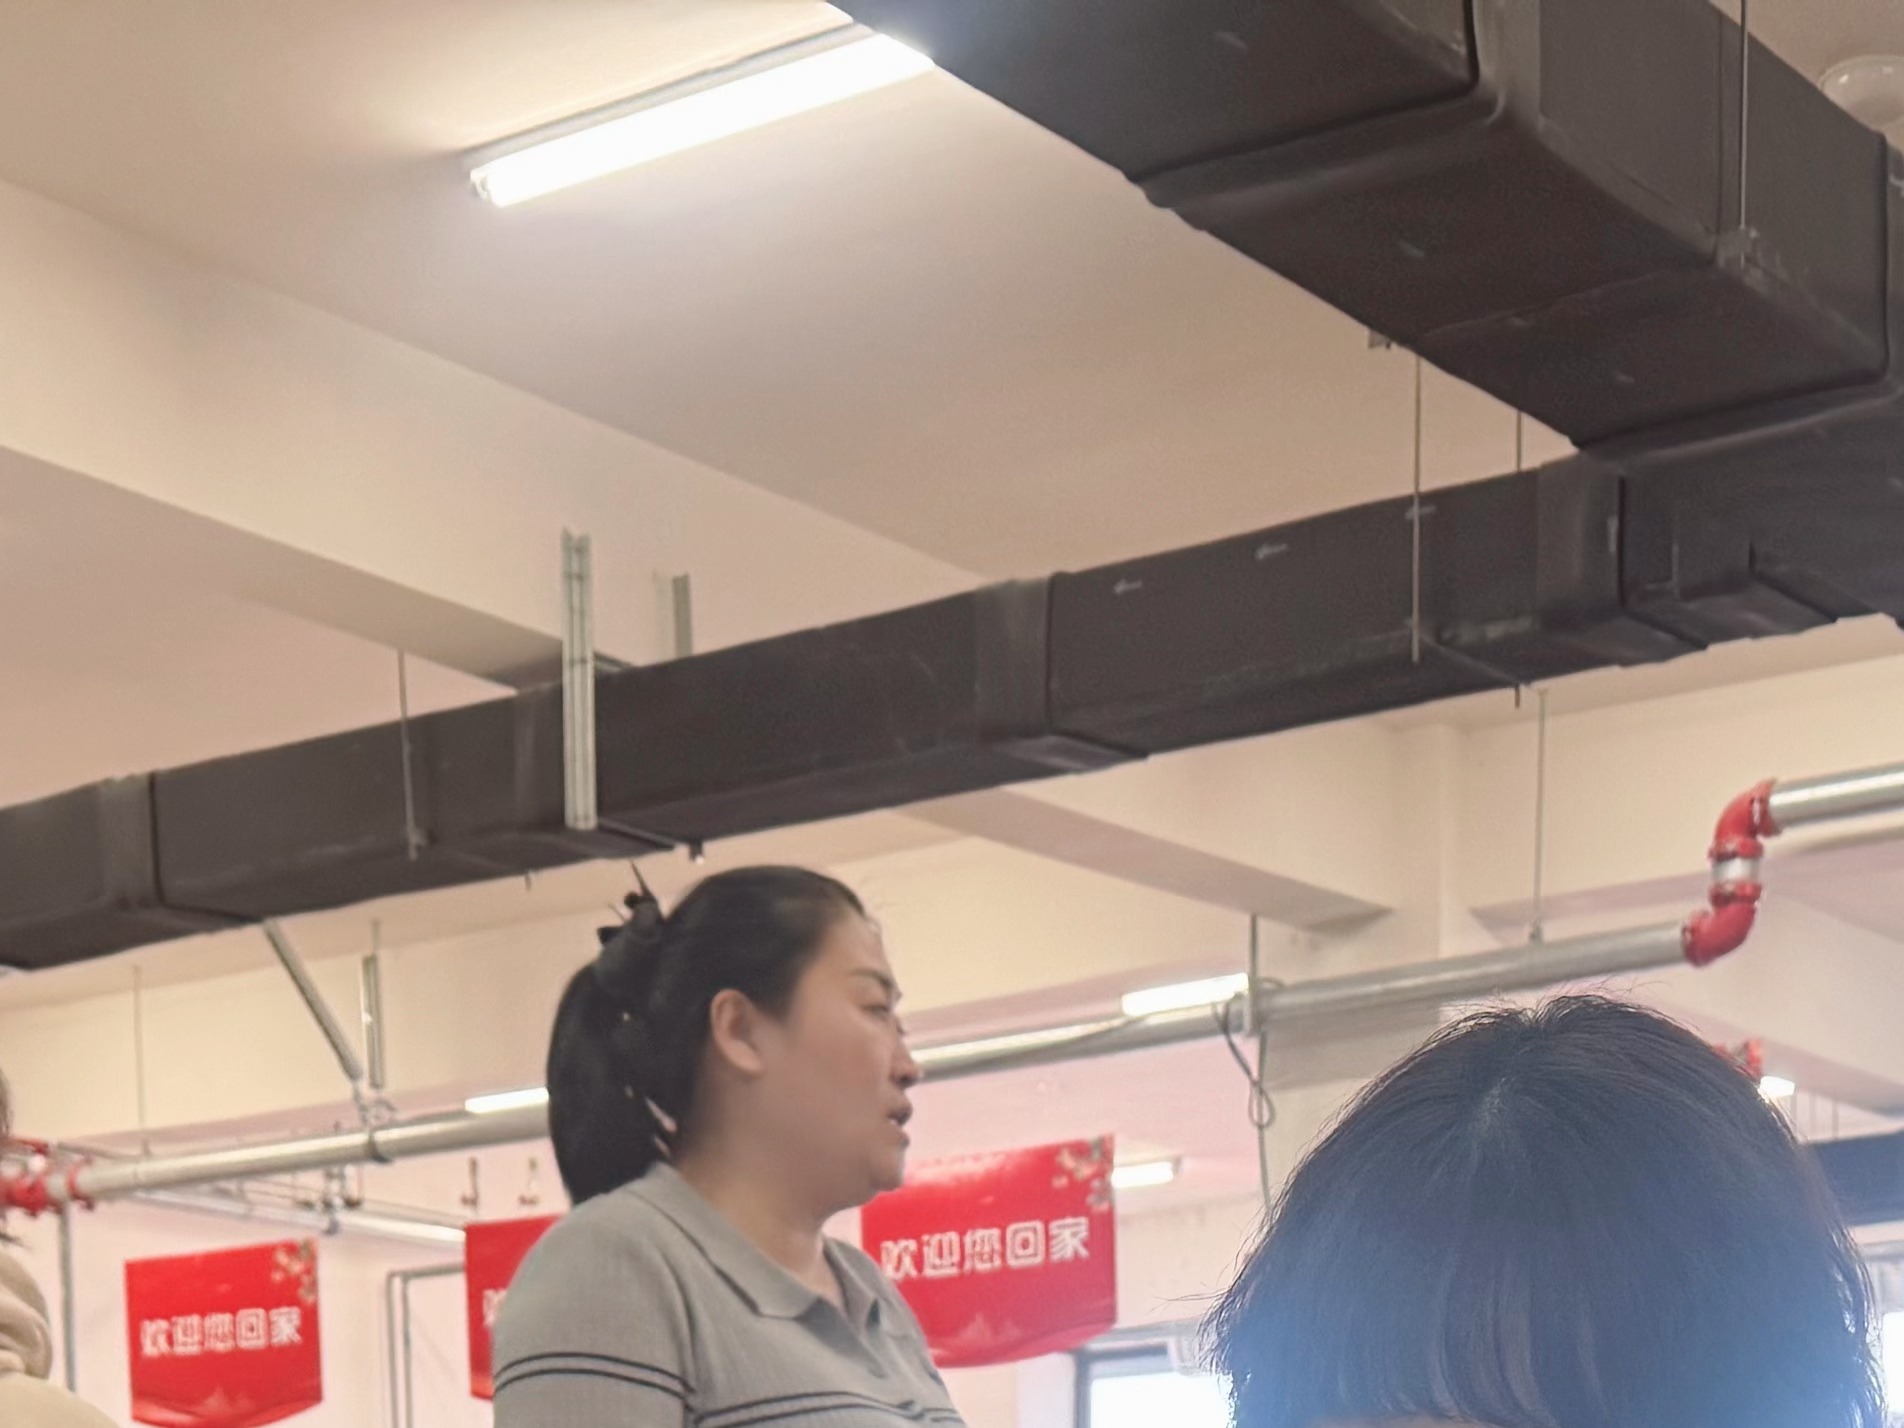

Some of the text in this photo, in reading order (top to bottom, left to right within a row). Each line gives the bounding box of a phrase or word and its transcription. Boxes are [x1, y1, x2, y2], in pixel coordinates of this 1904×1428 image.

[880, 1216, 1089, 1282] 欢迎您回家
